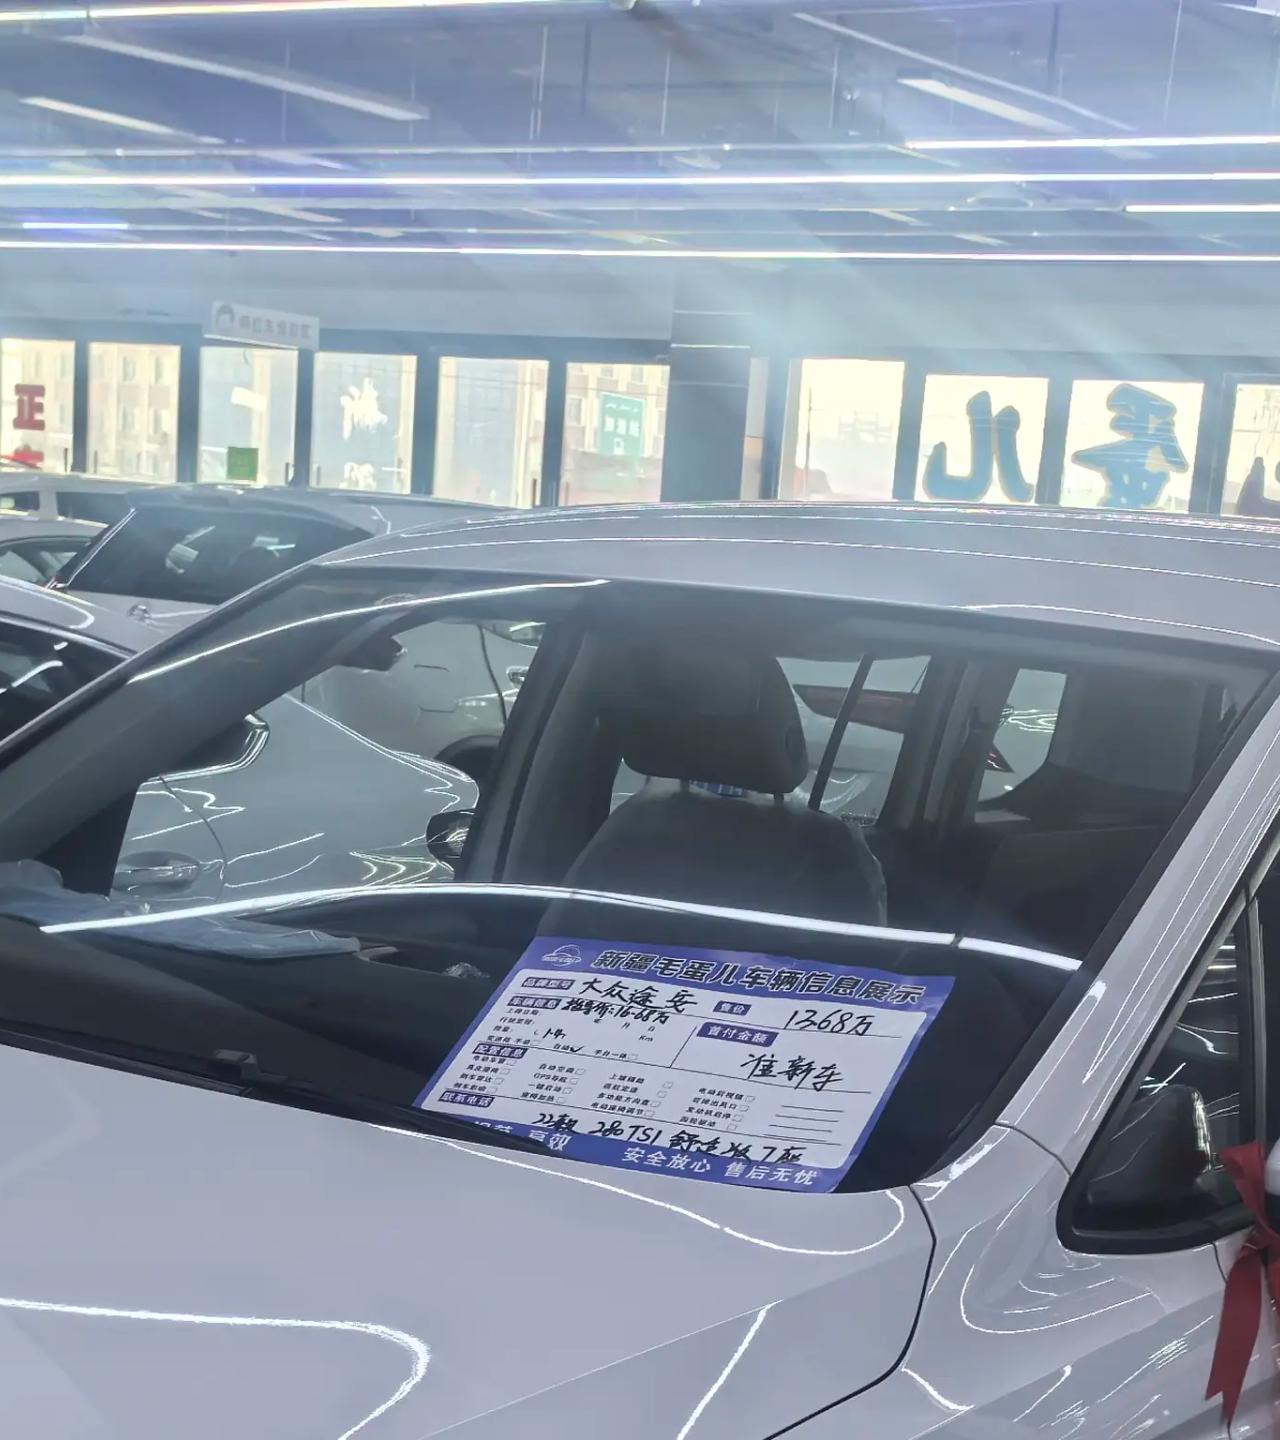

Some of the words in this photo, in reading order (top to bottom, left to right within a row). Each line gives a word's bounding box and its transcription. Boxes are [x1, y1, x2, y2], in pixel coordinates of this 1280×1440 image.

[590, 949, 926, 1006] 新疆毛蛋儿车辆信息展示
[718, 1002, 747, 1015] 售价
[706, 1025, 769, 1045] 首付金额
[475, 1043, 526, 1058] 配置信息
[740, 1051, 845, 1093] 准新车
[441, 1091, 493, 1107] 联系电话
[621, 1146, 712, 1173] 安全放心
[724, 1161, 819, 1187] 售后无忧
